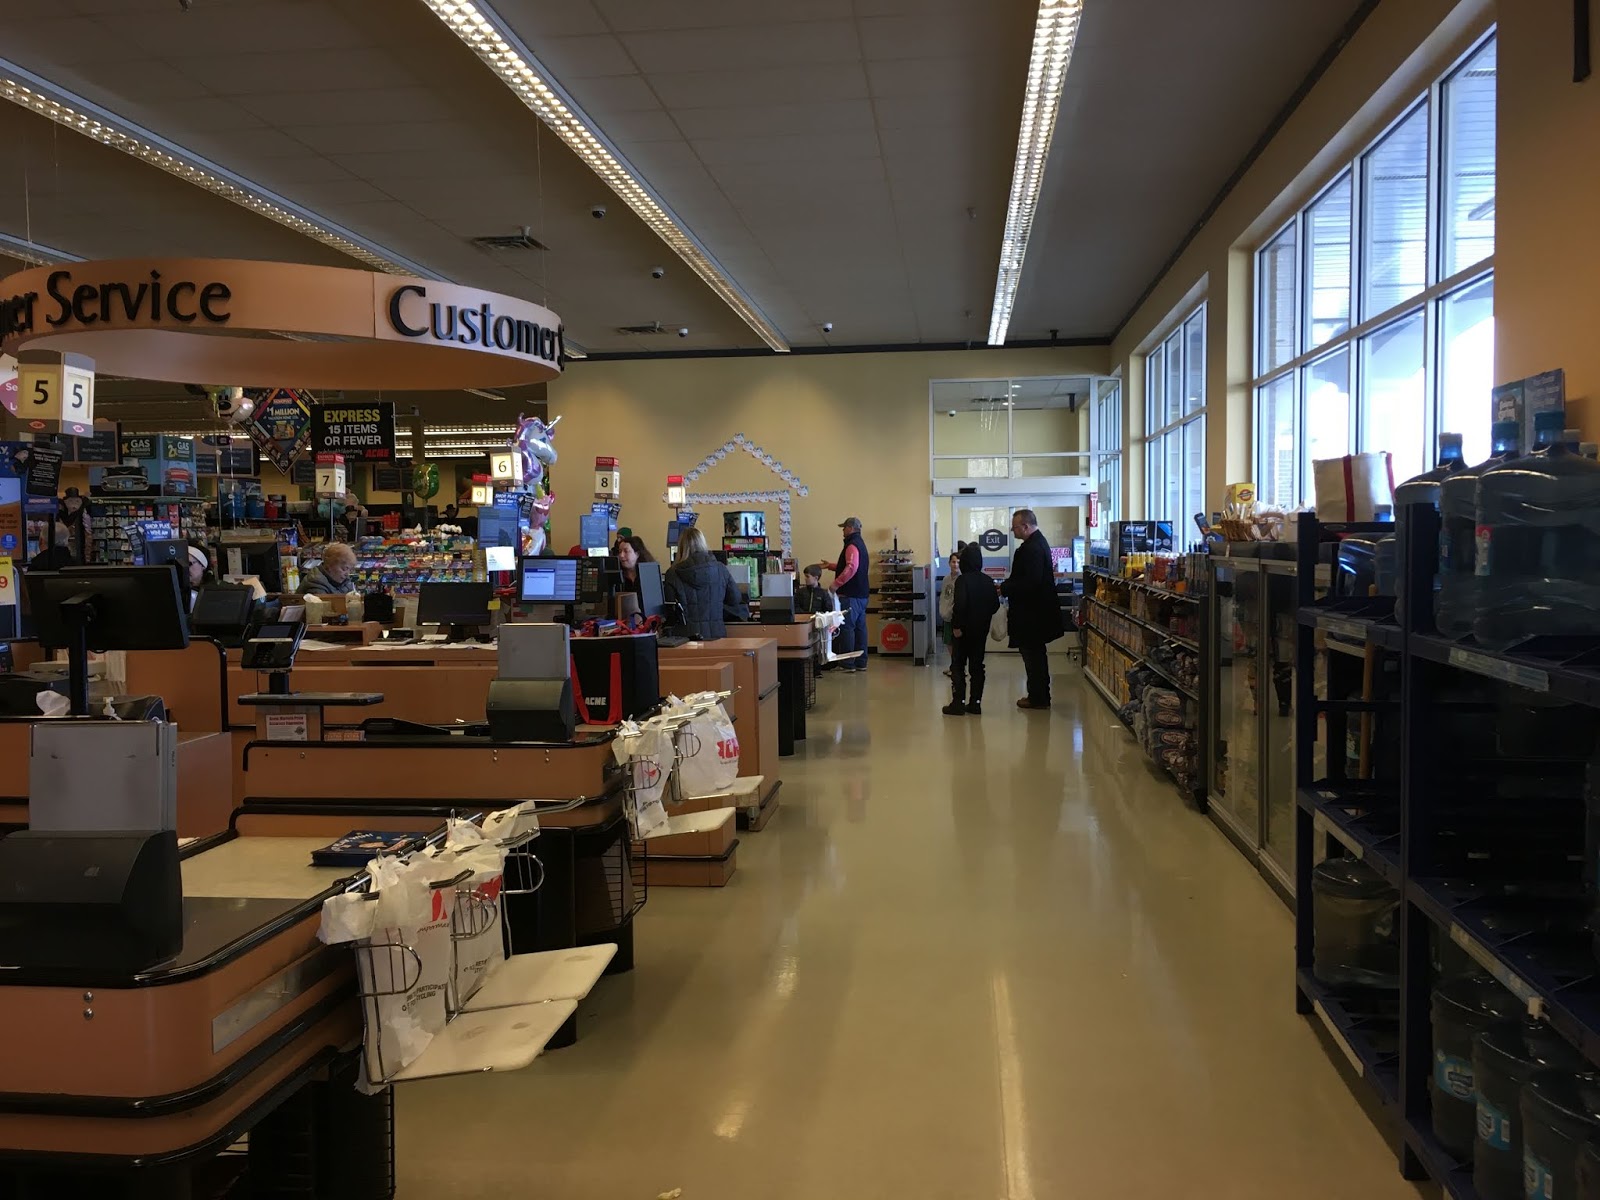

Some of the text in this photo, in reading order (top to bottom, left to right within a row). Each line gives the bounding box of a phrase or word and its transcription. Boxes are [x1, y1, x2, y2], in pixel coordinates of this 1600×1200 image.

[45, 270, 231, 326] Service
[389, 285, 558, 361] Customer
[33, 380, 49, 405] 5
[71, 383, 83, 408] 5
[275, 408, 300, 416] MILLION
[323, 409, 381, 423] EXPRESS
[328, 424, 378, 434] 15 ITEMS
[130, 439, 151, 448] GAS
[177, 441, 190, 450] GAS
[324, 435, 382, 446] OR FEWER
[498, 460, 507, 473] 6
[322, 475, 330, 487] 7
[337, 476, 342, 487] 7
[601, 477, 609, 488] 8
[986, 536, 1001, 544] Exit
